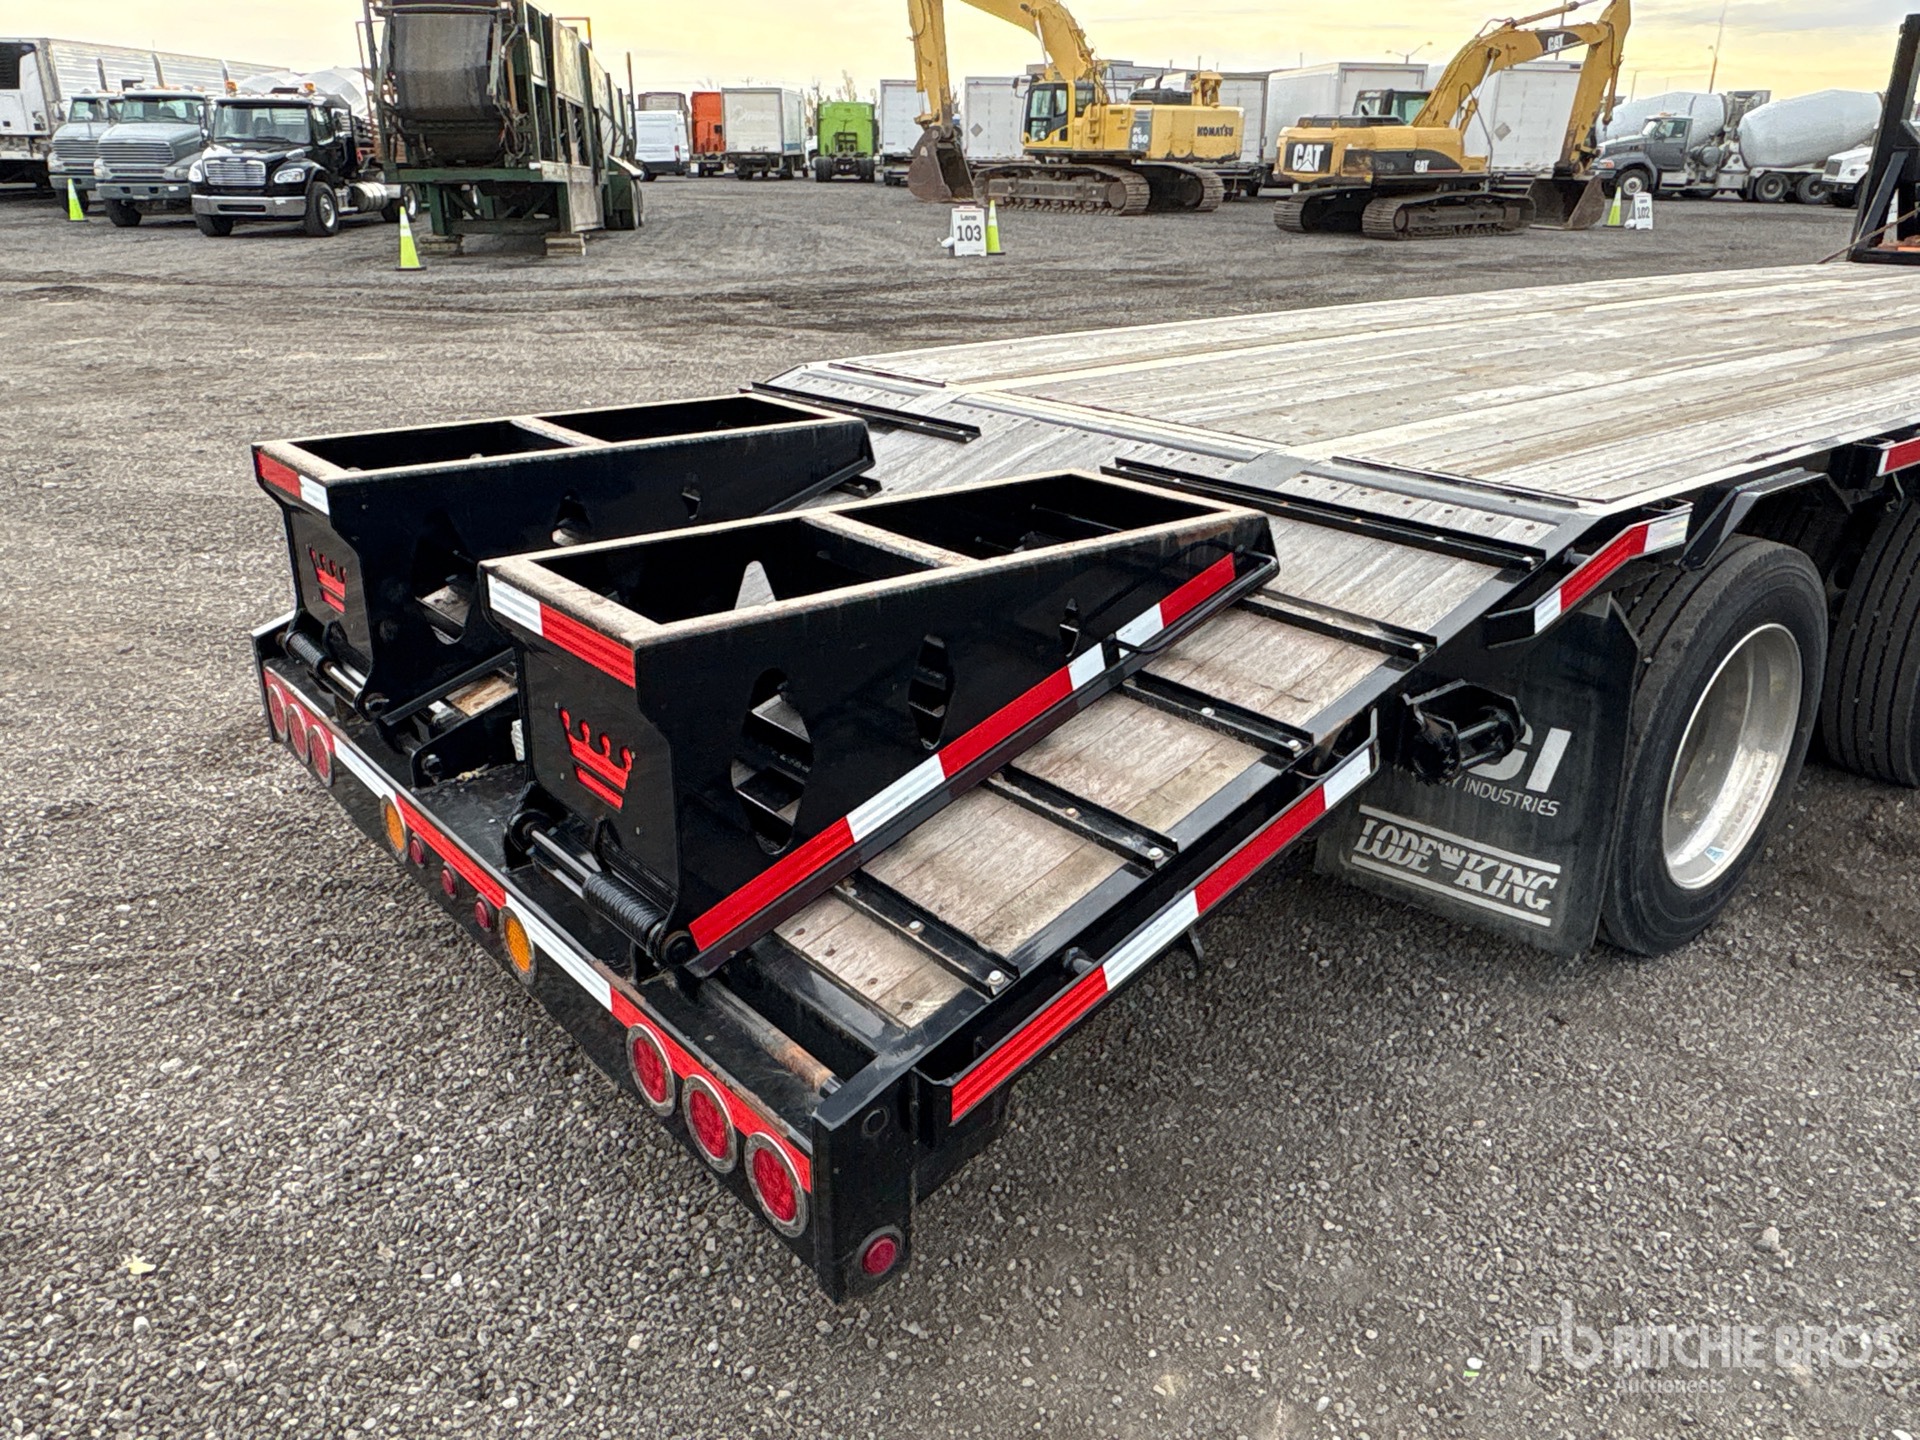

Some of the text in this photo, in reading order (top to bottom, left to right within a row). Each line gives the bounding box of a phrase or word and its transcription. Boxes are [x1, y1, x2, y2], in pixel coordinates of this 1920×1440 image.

[1197, 124, 1234, 136] KOMATSU
[1292, 144, 1324, 172] CAT
[1414, 160, 1430, 173] CAT
[957, 225, 982, 241] 103
[1463, 777, 1560, 817] INDUSTRIES
[1353, 819, 1557, 911] LODE KING
